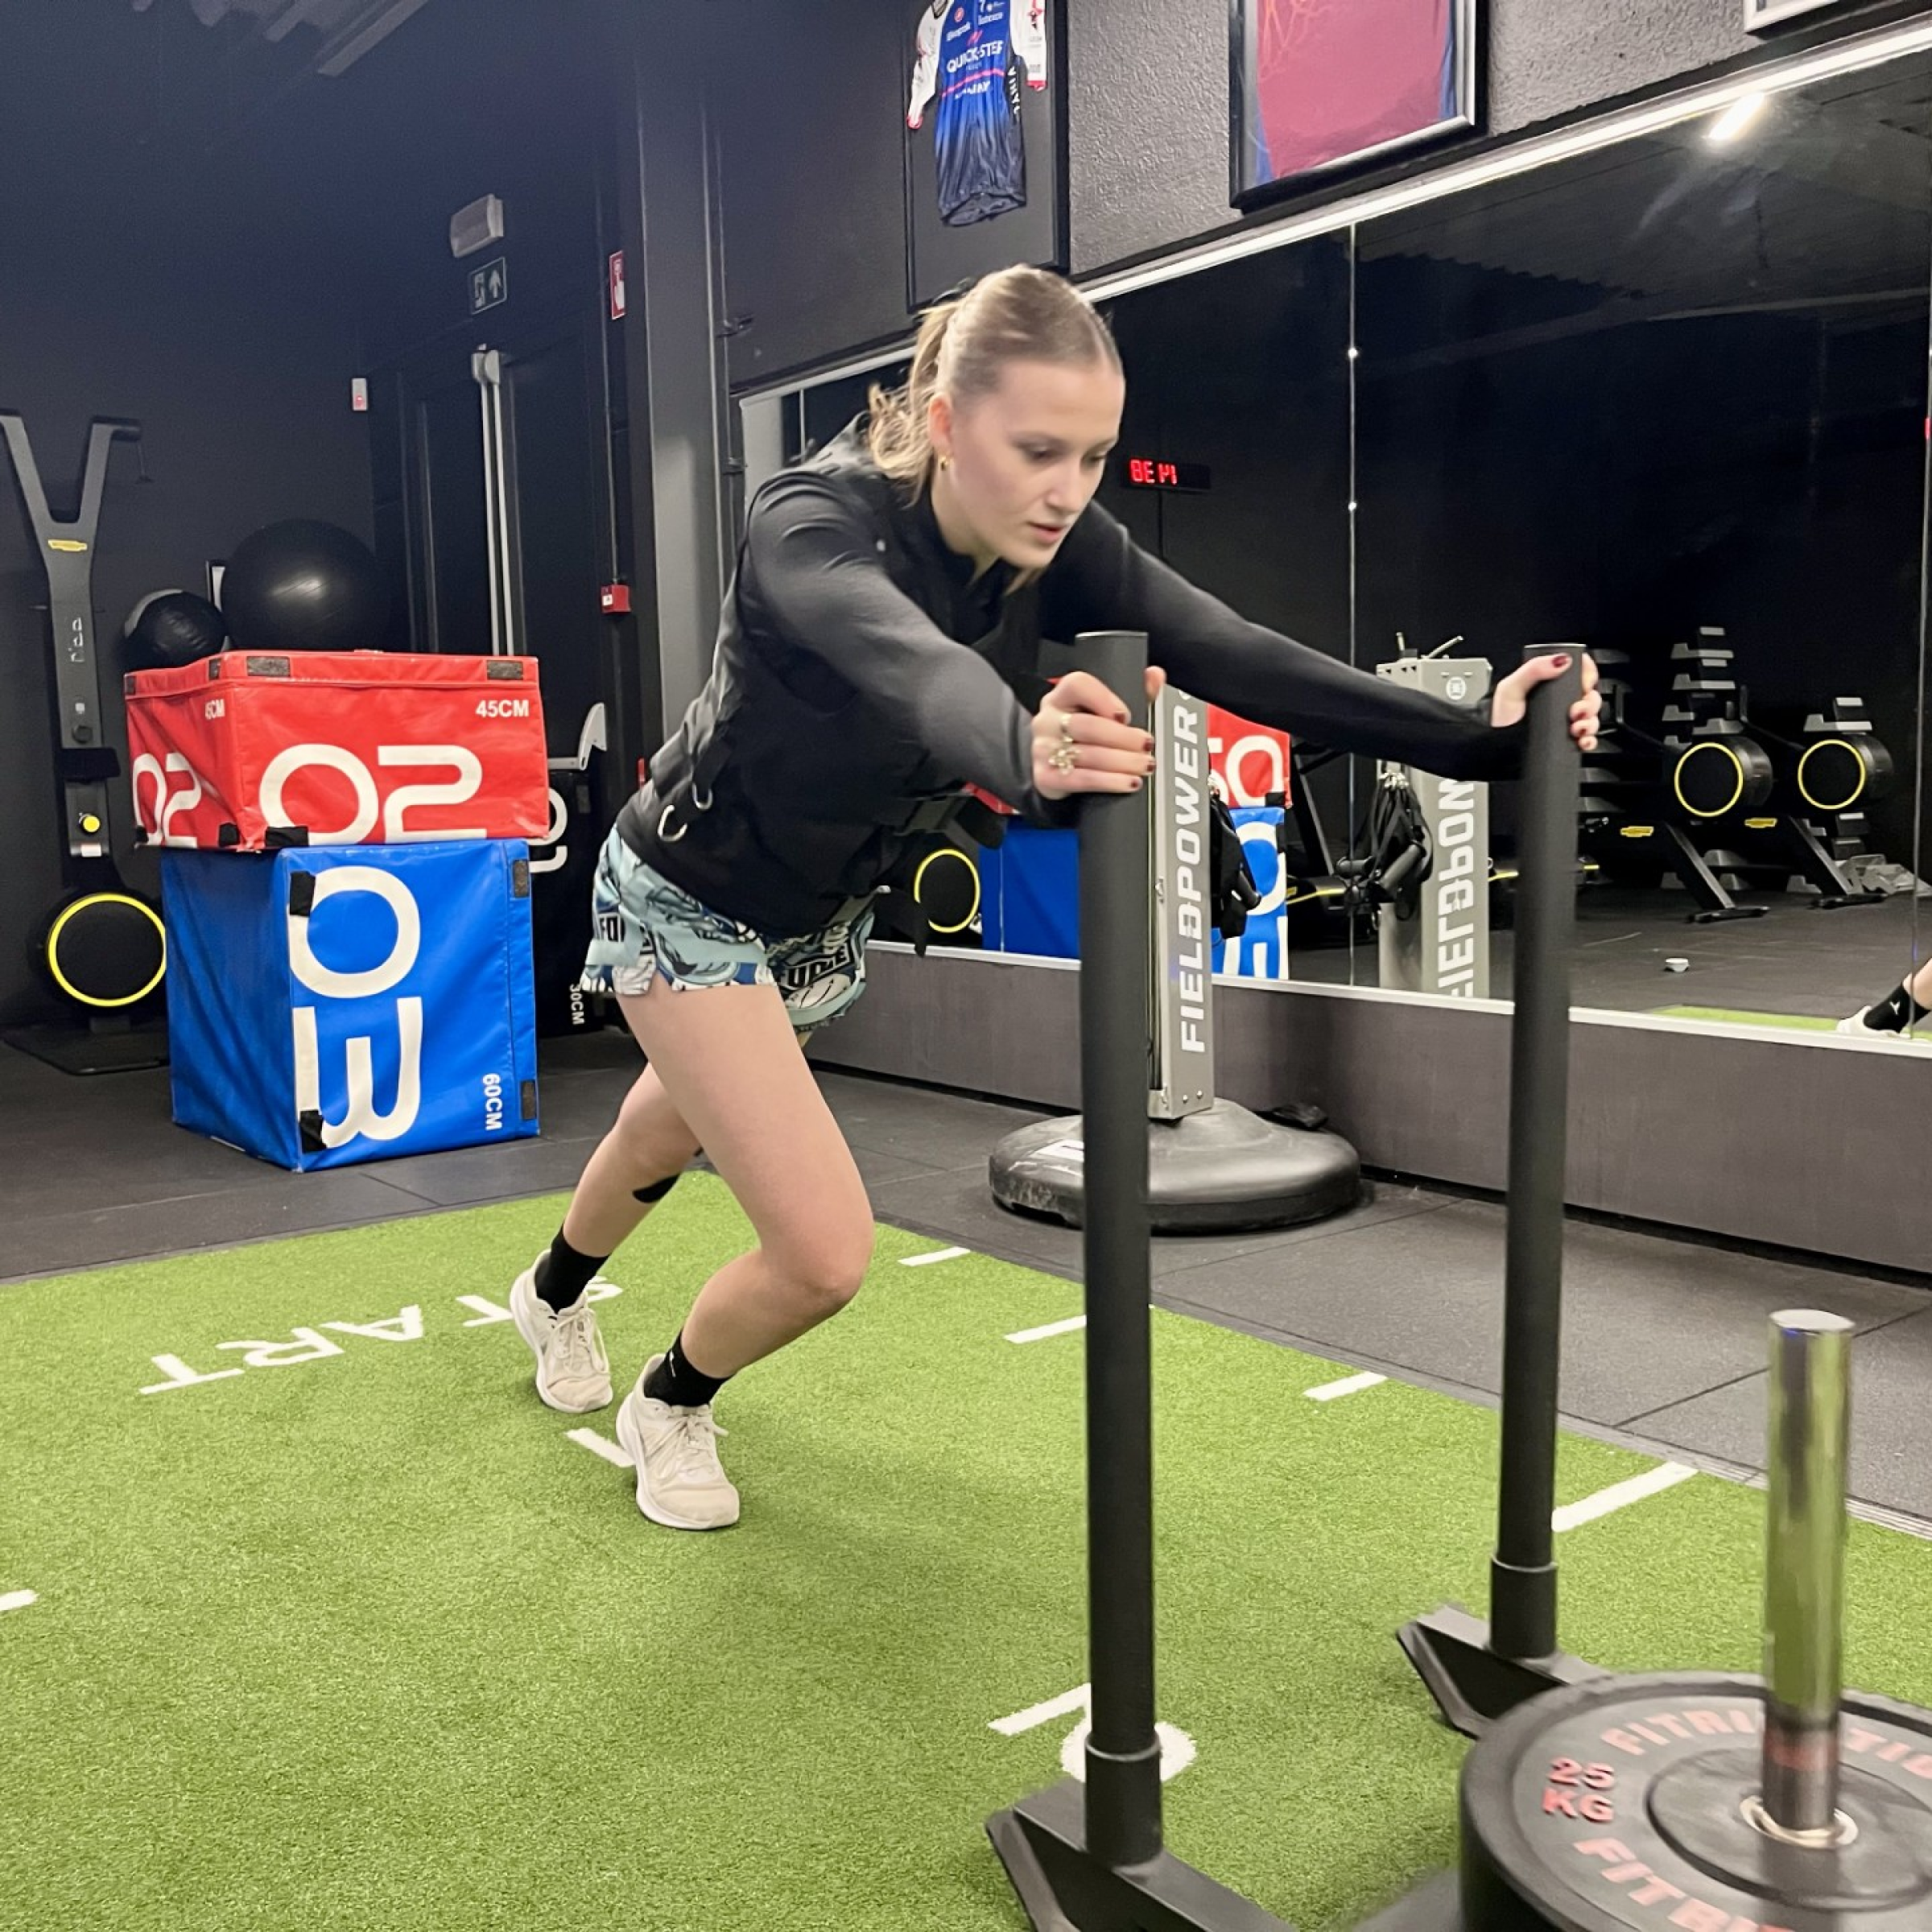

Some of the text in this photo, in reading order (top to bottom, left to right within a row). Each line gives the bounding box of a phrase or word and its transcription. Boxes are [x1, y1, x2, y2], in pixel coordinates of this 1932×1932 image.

[476, 700, 529, 718] 45CM
[133, 753, 201, 848] 02
[259, 744, 486, 846] 02
[1173, 705, 1206, 1053] FIELDPOWER
[287, 865, 423, 1150] 03
[570, 984, 586, 1026] 30CM
[482, 1072, 503, 1131] 60CM
[1547, 1757, 1615, 1789] 25
[1541, 1787, 1614, 1823] KG
